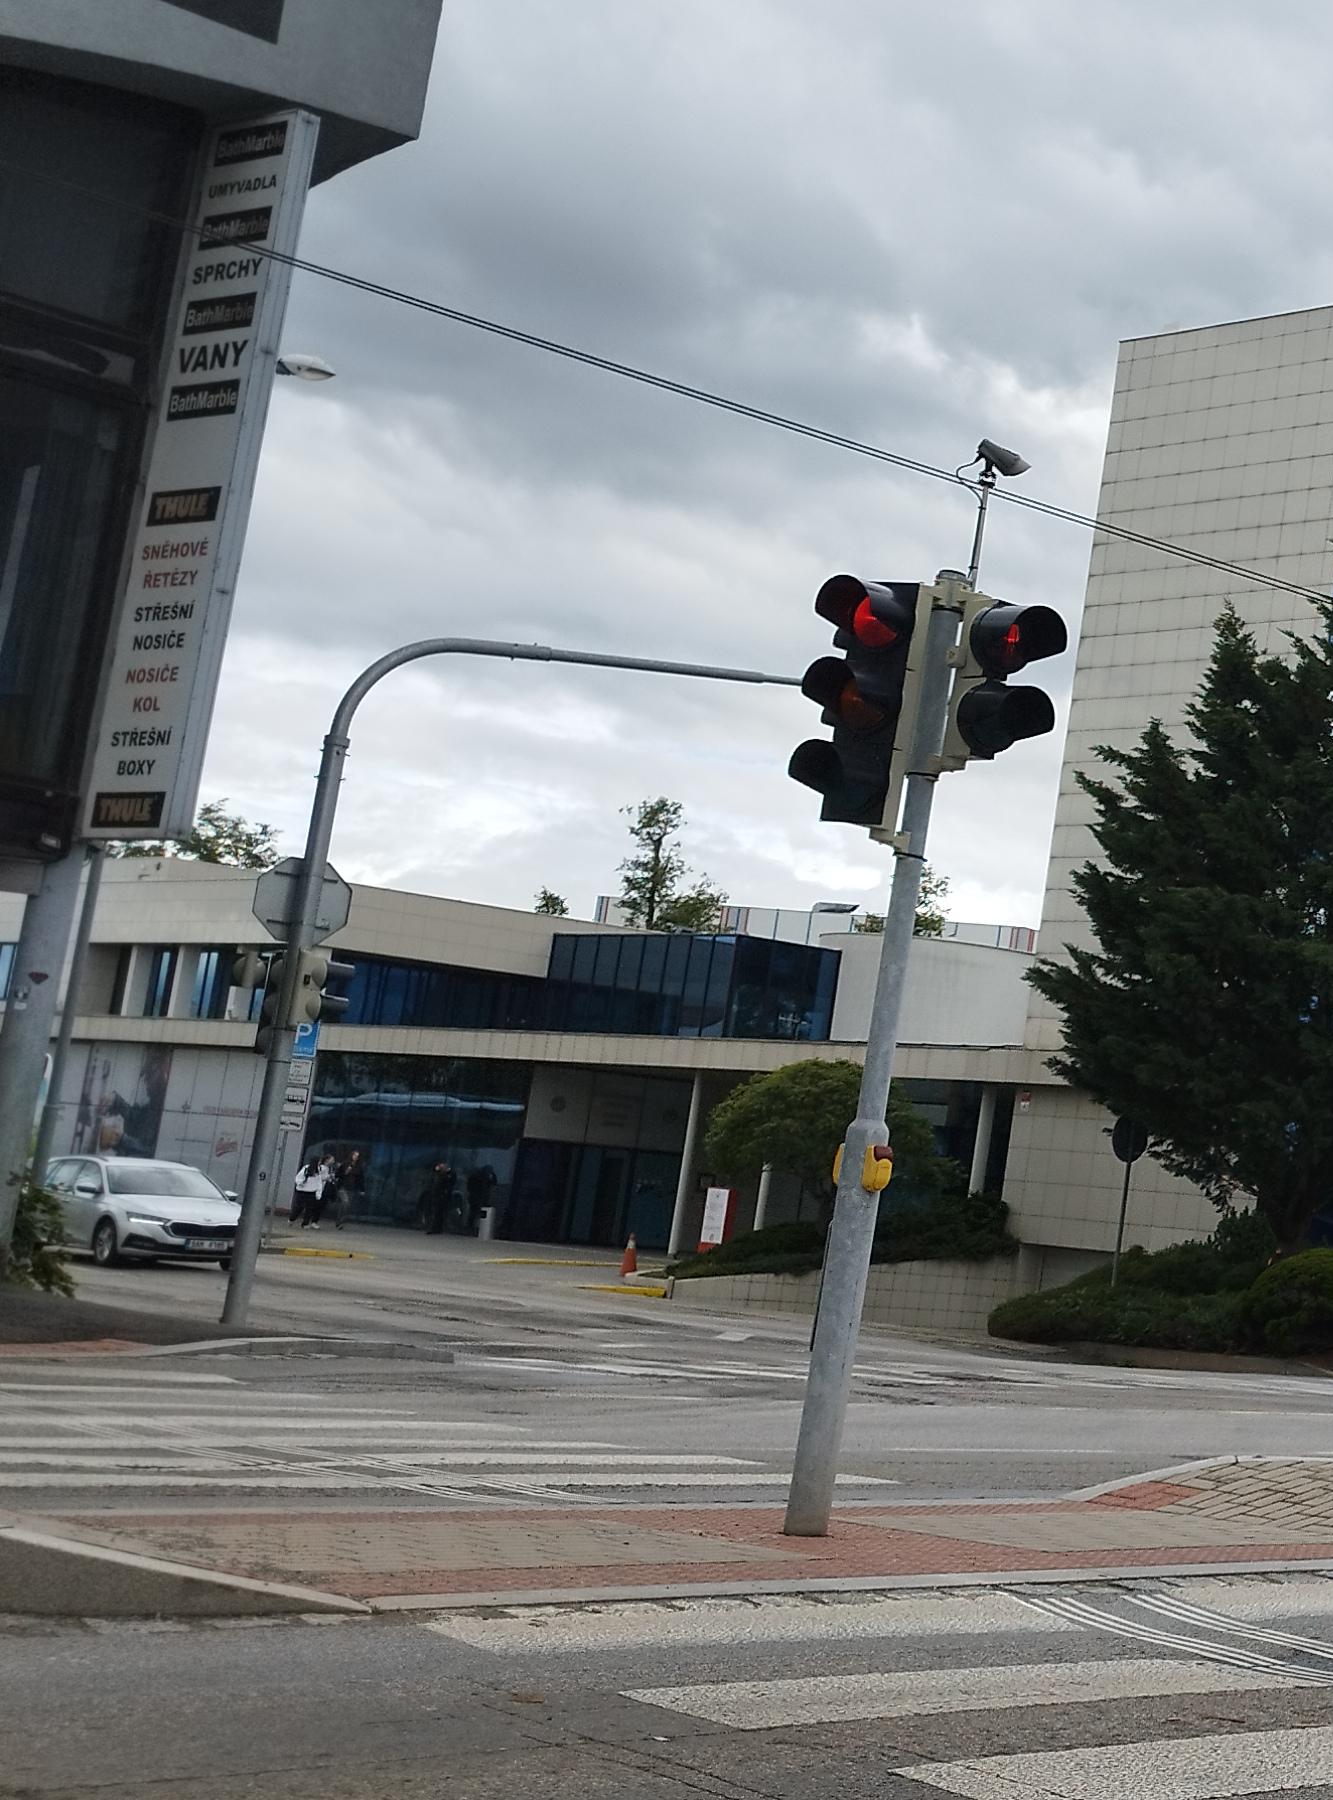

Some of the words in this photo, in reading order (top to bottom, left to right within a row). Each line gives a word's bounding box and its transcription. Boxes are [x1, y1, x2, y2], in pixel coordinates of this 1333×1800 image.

[208, 174, 277, 199] UMYVADLA
[193, 257, 263, 285] SPRCHY
[179, 339, 248, 374] VANY
[169, 387, 238, 413] BathMarble
[154, 493, 210, 520] THULE
[134, 600, 196, 623] STŘEŠNÍ
[133, 630, 186, 651] NOSIČE
[125, 664, 179, 684] NOSIČE
[133, 696, 161, 713] KOL
[110, 726, 173, 747] STŘEŠNÍ
[116, 759, 156, 776] BOXY
[96, 797, 153, 822] THULE
[294, 1023, 313, 1045] P
